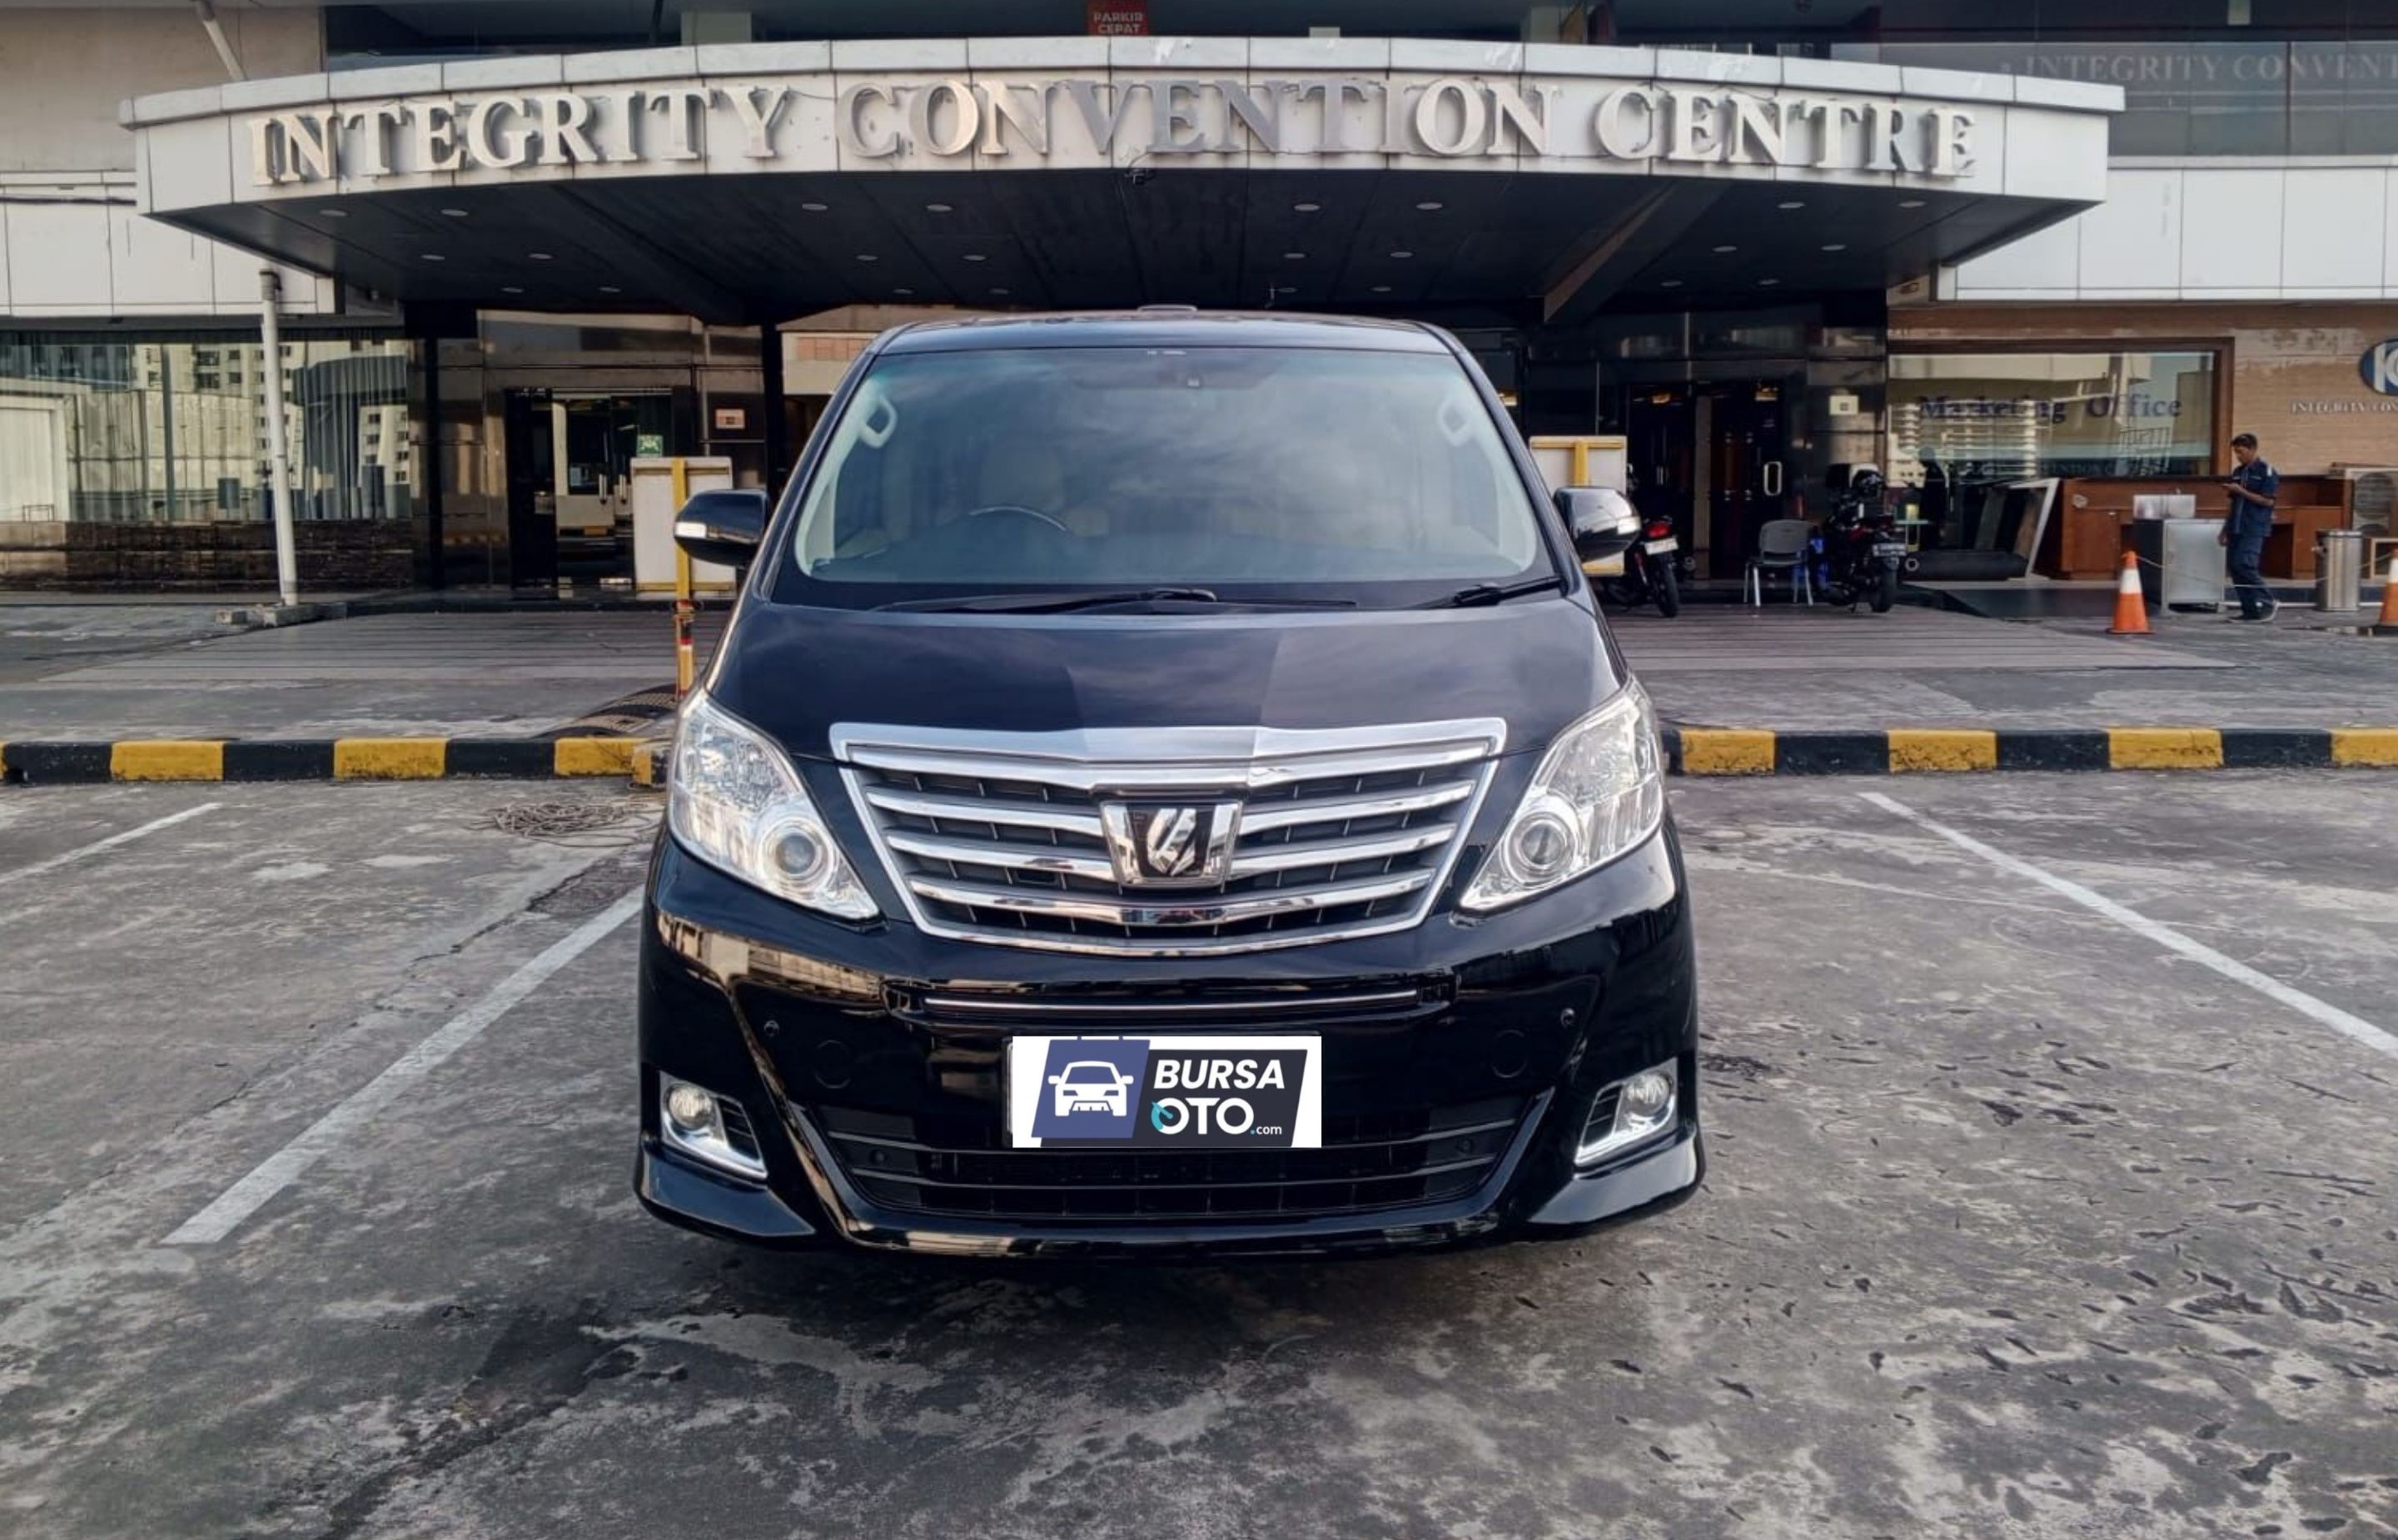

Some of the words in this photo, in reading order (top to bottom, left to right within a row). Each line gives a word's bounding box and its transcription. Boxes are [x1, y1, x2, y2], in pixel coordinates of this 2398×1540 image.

[1093, 12, 1143, 22] PARKIR
[1097, 23, 1140, 34] CEPAT
[2026, 54, 2222, 81] INTEGRITY
[250, 85, 792, 186] INTEGRITY
[838, 79, 1559, 157] CONVENTION
[1597, 85, 1975, 176] CENTRE
[2087, 394, 2182, 418] Ofice
